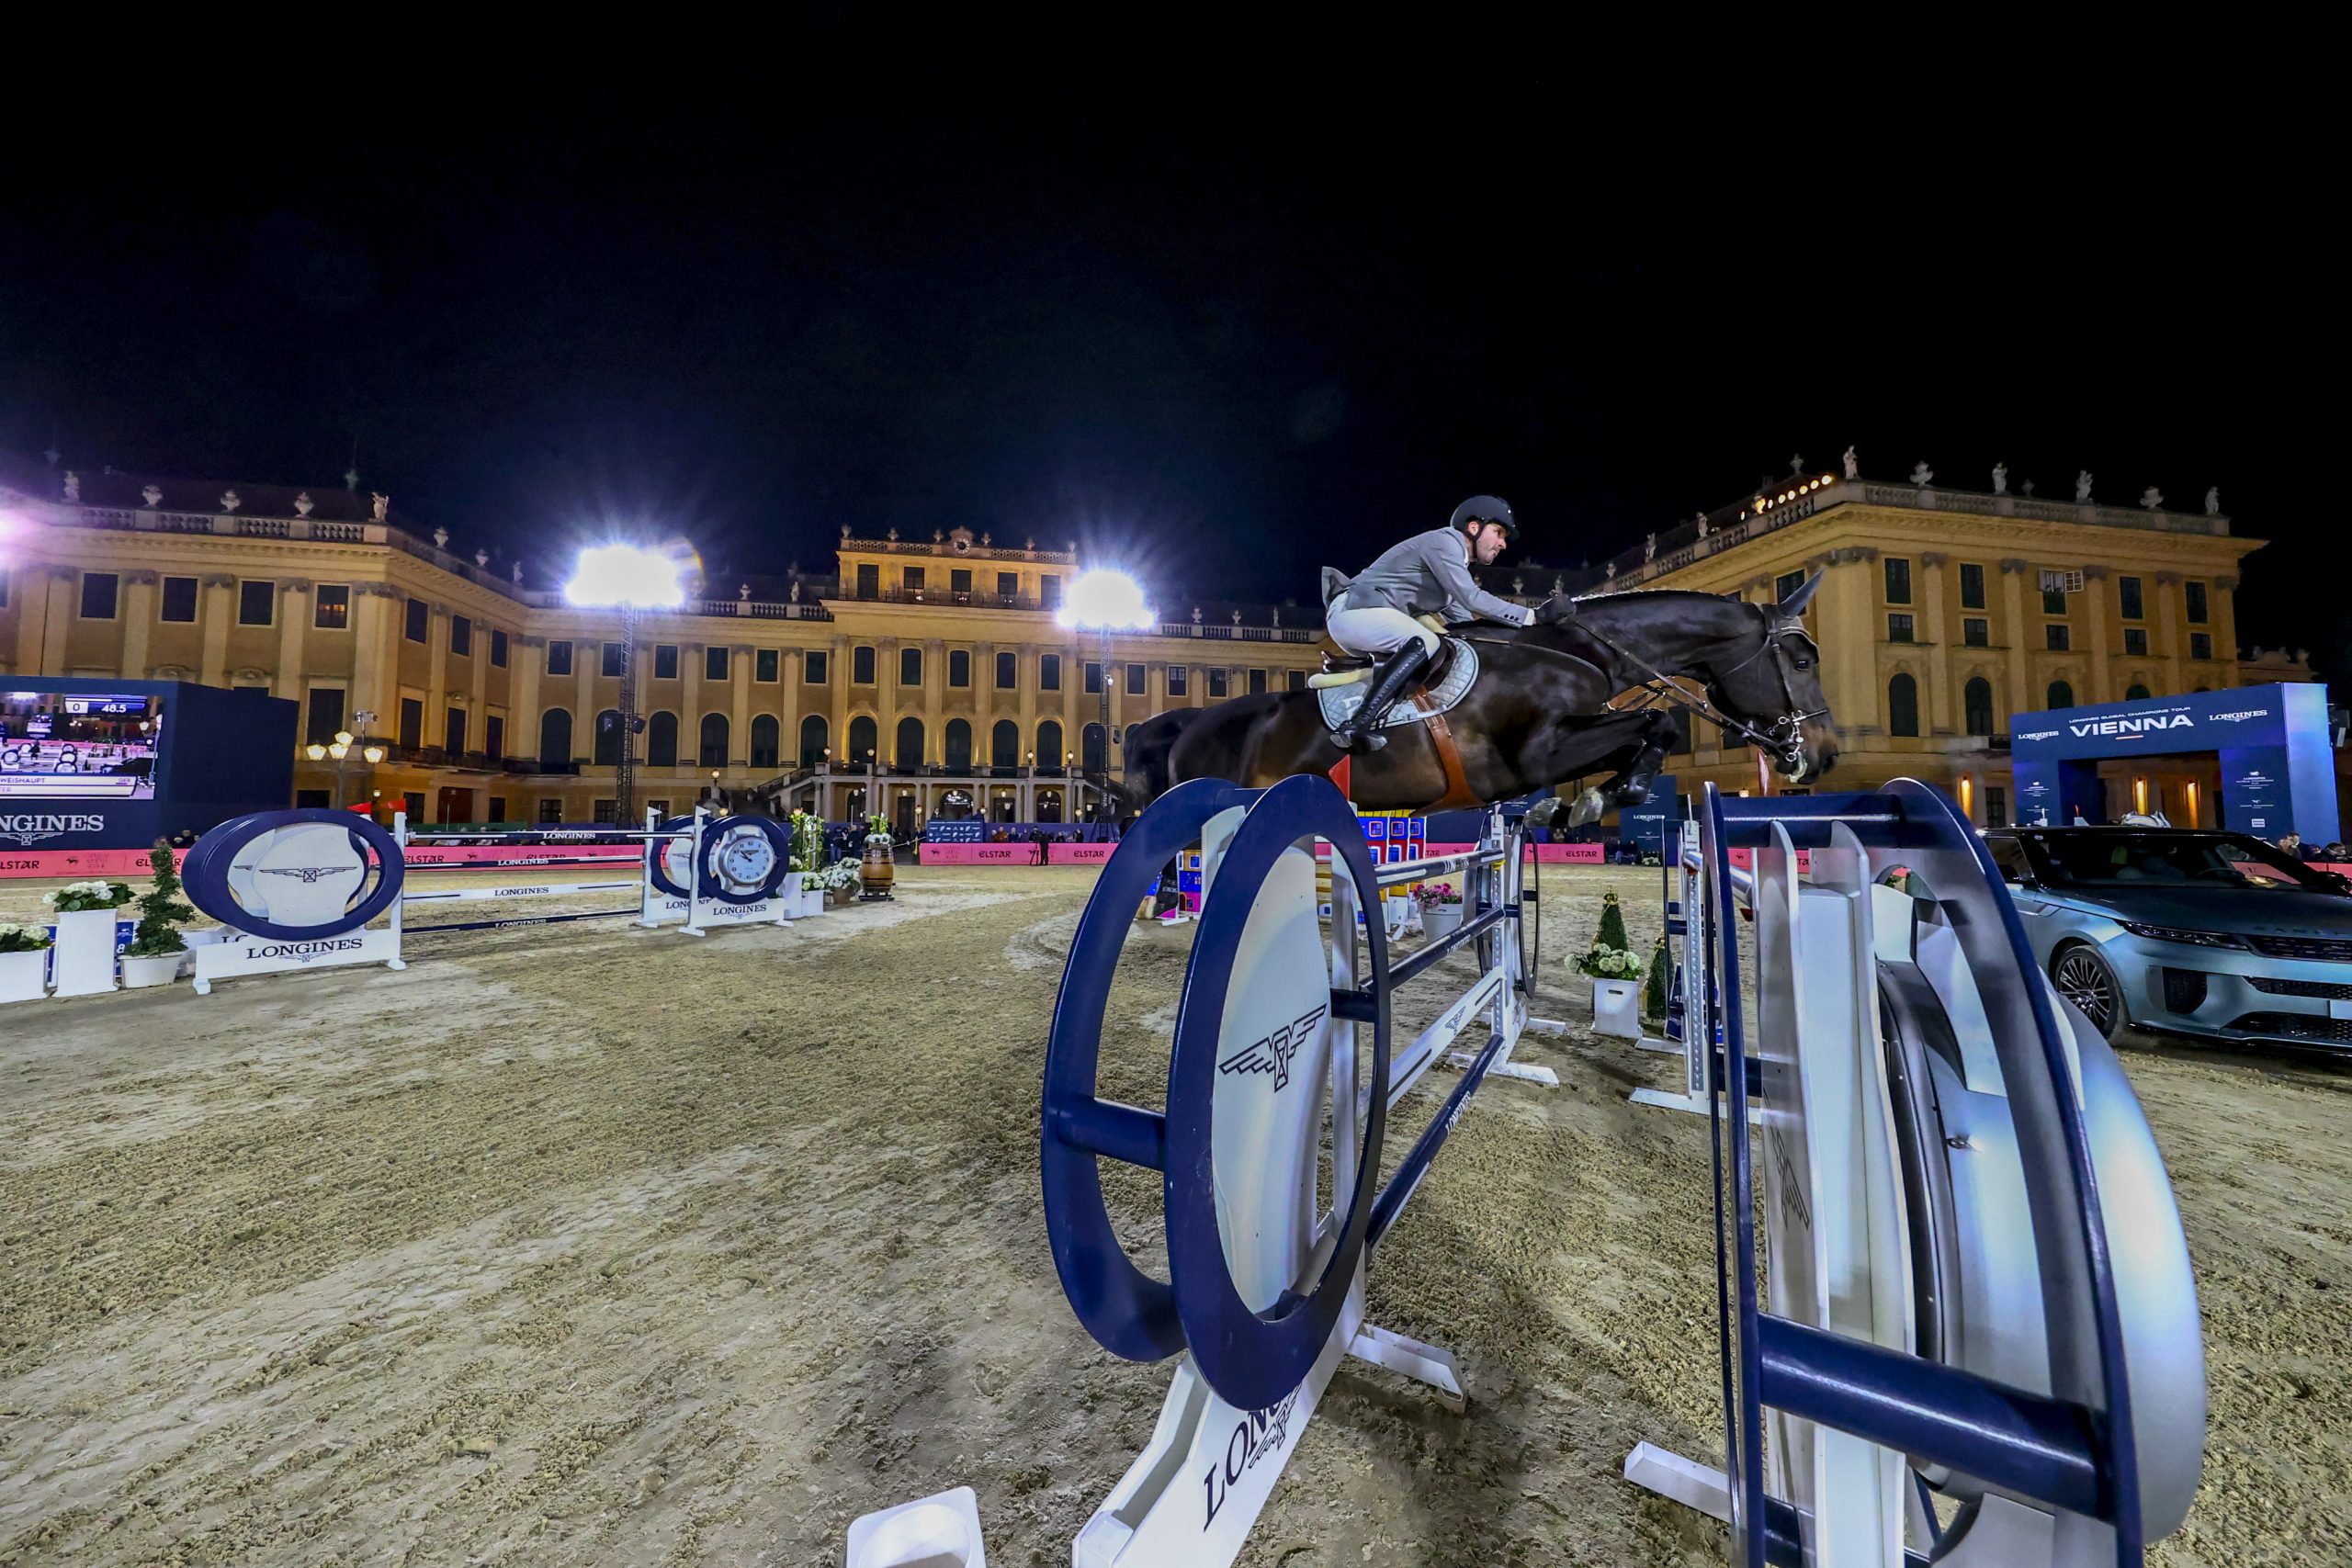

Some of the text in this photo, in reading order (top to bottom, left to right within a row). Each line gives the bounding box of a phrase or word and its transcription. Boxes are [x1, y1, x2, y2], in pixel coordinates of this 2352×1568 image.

[73, 703, 127, 713] 0 48.5
[2127, 708, 2169, 717] CHAMPIONS
[2209, 709, 2267, 721] LONGINES
[2069, 714, 2194, 738] VIENNA
[2018, 730, 2059, 739] LONGINES
[0, 814, 104, 832] NGINES
[0, 860, 40, 870] LSTAR
[497, 858, 549, 866] LONGINES
[494, 887, 549, 897] LONGINES
[713, 904, 767, 916] LONGINES
[246, 938, 363, 960] LONGINES
